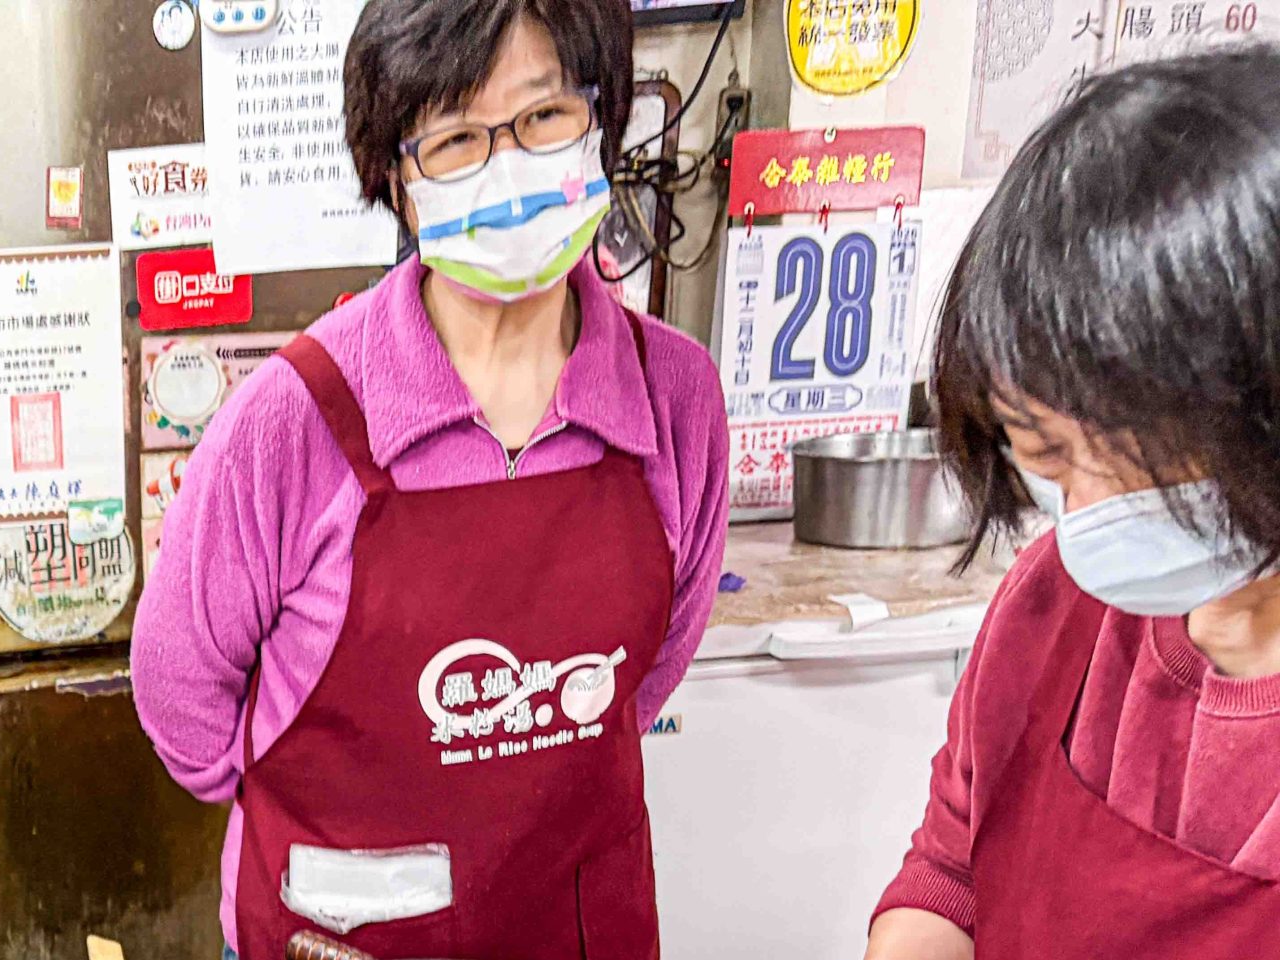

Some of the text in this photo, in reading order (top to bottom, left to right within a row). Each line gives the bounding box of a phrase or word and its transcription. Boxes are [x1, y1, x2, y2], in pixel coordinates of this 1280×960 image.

[278, 8, 323, 35] 公告
[1225, 2, 1257, 33] 60
[759, 151, 896, 188] 合泰雜糧行
[770, 232, 877, 380] 28
[783, 386, 845, 410] 星期三
[442, 661, 556, 707] 羅媽媽
